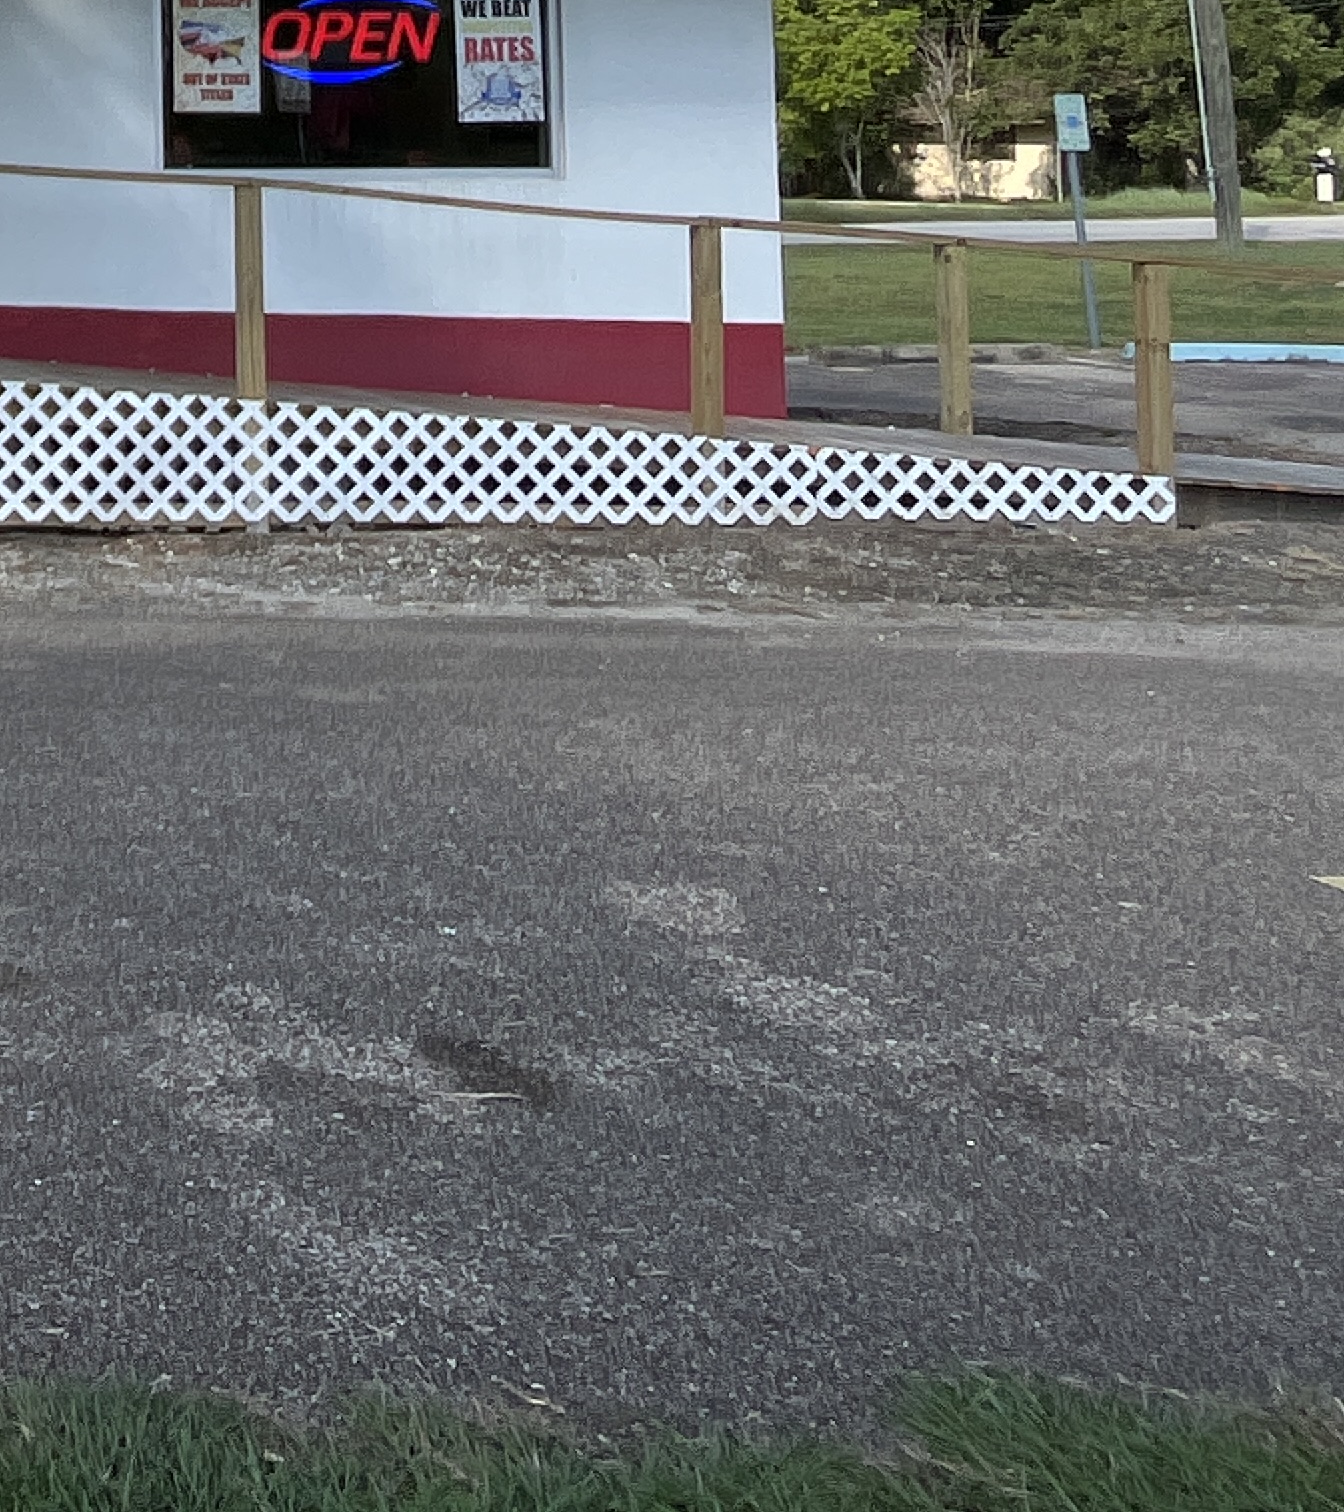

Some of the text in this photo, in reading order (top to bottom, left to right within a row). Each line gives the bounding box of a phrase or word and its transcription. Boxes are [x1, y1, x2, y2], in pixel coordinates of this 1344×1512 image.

[460, 0, 532, 18] WE BEAT
[261, 10, 441, 62] OPEN
[464, 36, 535, 64] RATES
